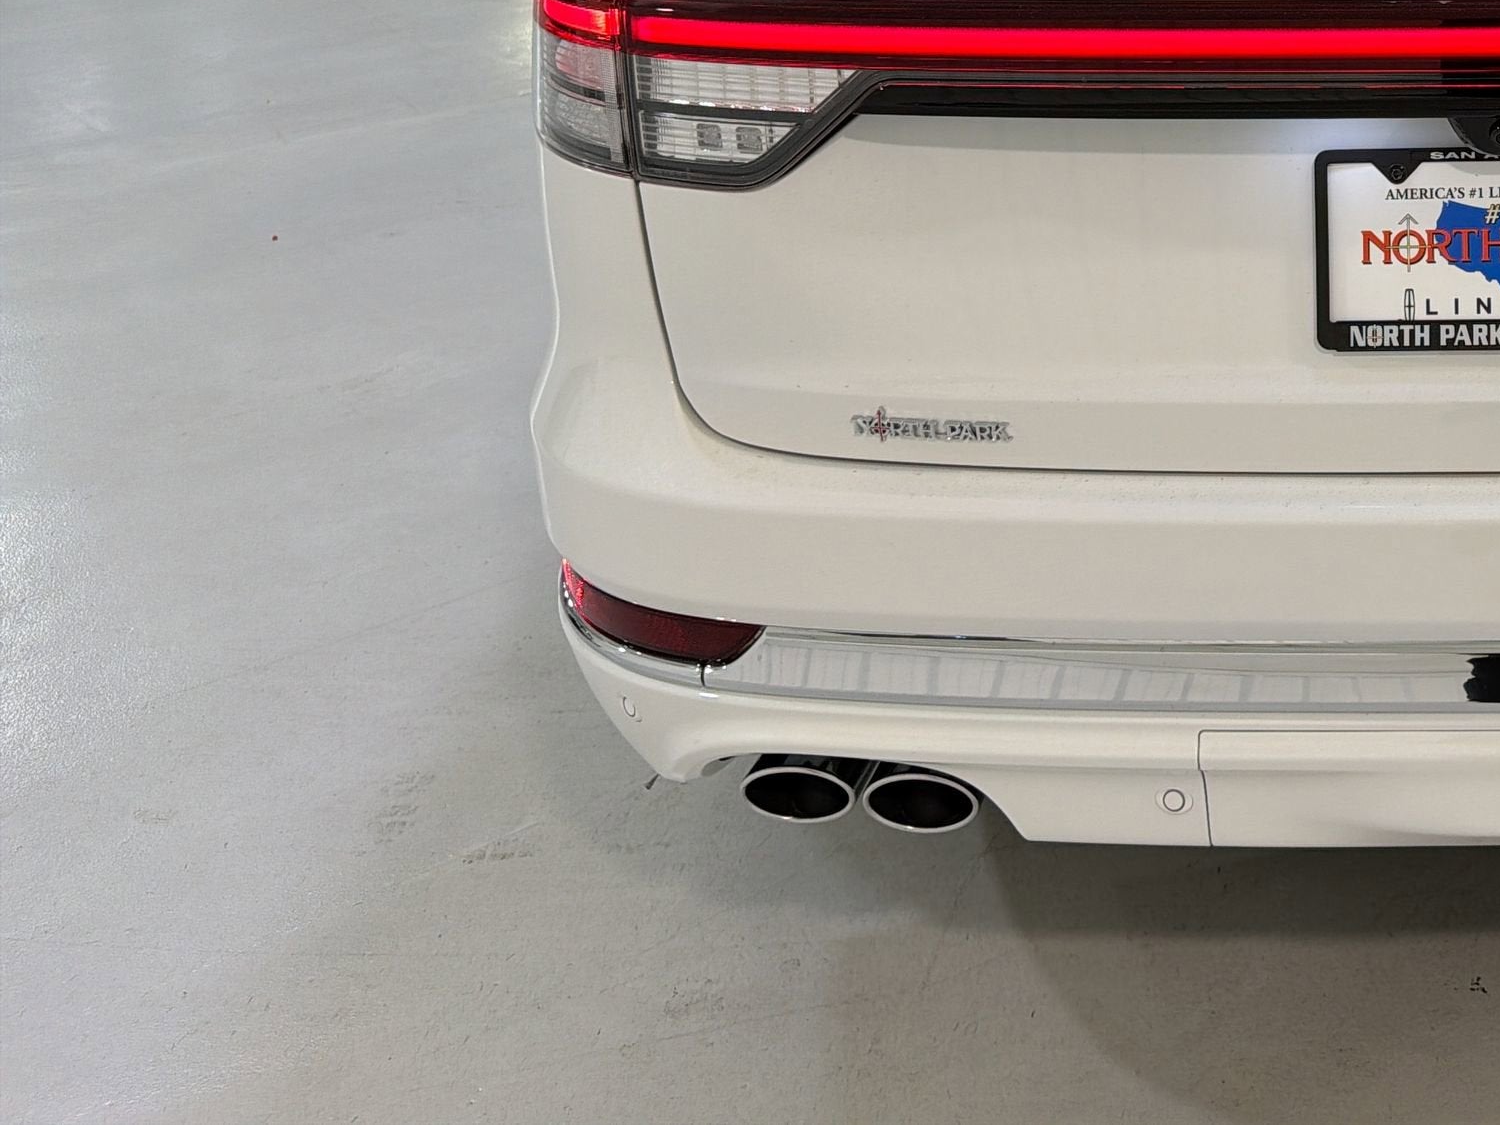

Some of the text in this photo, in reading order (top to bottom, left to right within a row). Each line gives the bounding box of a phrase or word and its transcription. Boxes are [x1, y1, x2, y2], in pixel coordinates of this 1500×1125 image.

[1430, 151, 1476, 159] SAN
[1385, 187, 1465, 201] AMERICA'S
[1469, 186, 1484, 199] #1
[1350, 324, 1431, 347] NORTH
[946, 420, 1011, 442] PARK
